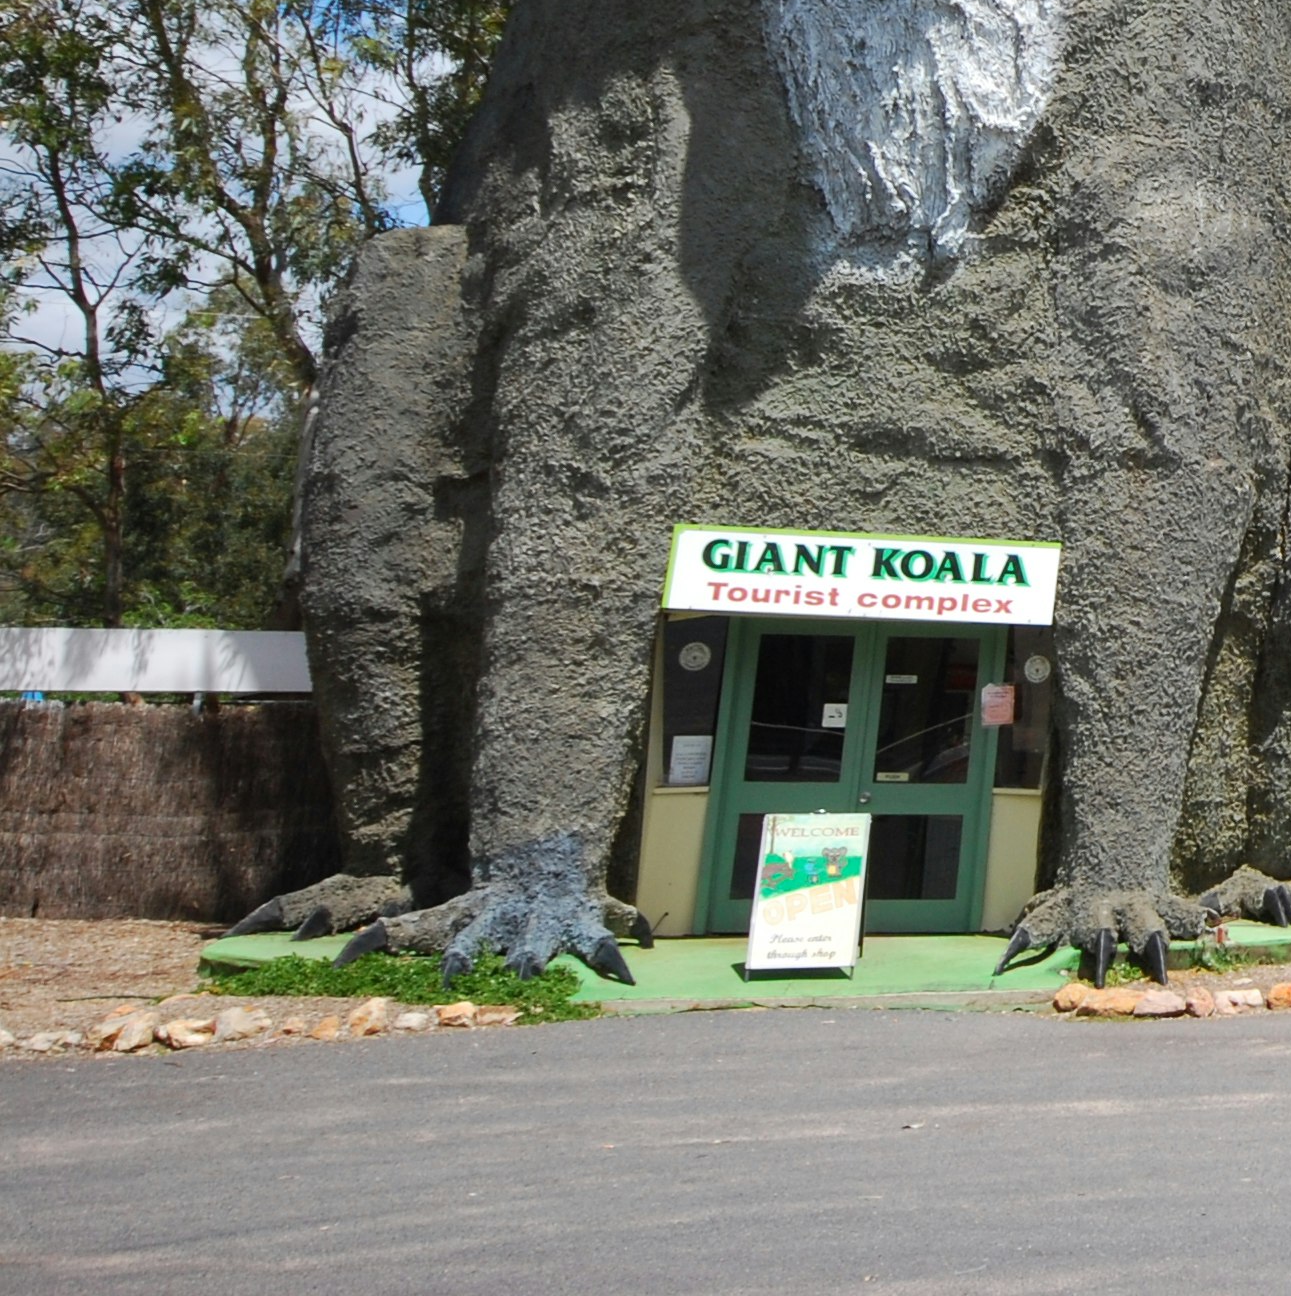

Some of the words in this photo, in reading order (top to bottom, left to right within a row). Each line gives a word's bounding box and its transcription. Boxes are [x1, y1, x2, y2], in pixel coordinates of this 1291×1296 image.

[702, 538, 855, 578] GIANT
[871, 548, 1031, 587] KOALA
[706, 581, 839, 607] Tourist
[856, 590, 1014, 616] complex
[775, 826, 860, 838] WELCOME
[762, 877, 859, 926] OPEN
[769, 934, 804, 944] Please
[807, 935, 833, 943] enter
[766, 949, 808, 960] through
[812, 948, 837, 960] shop
